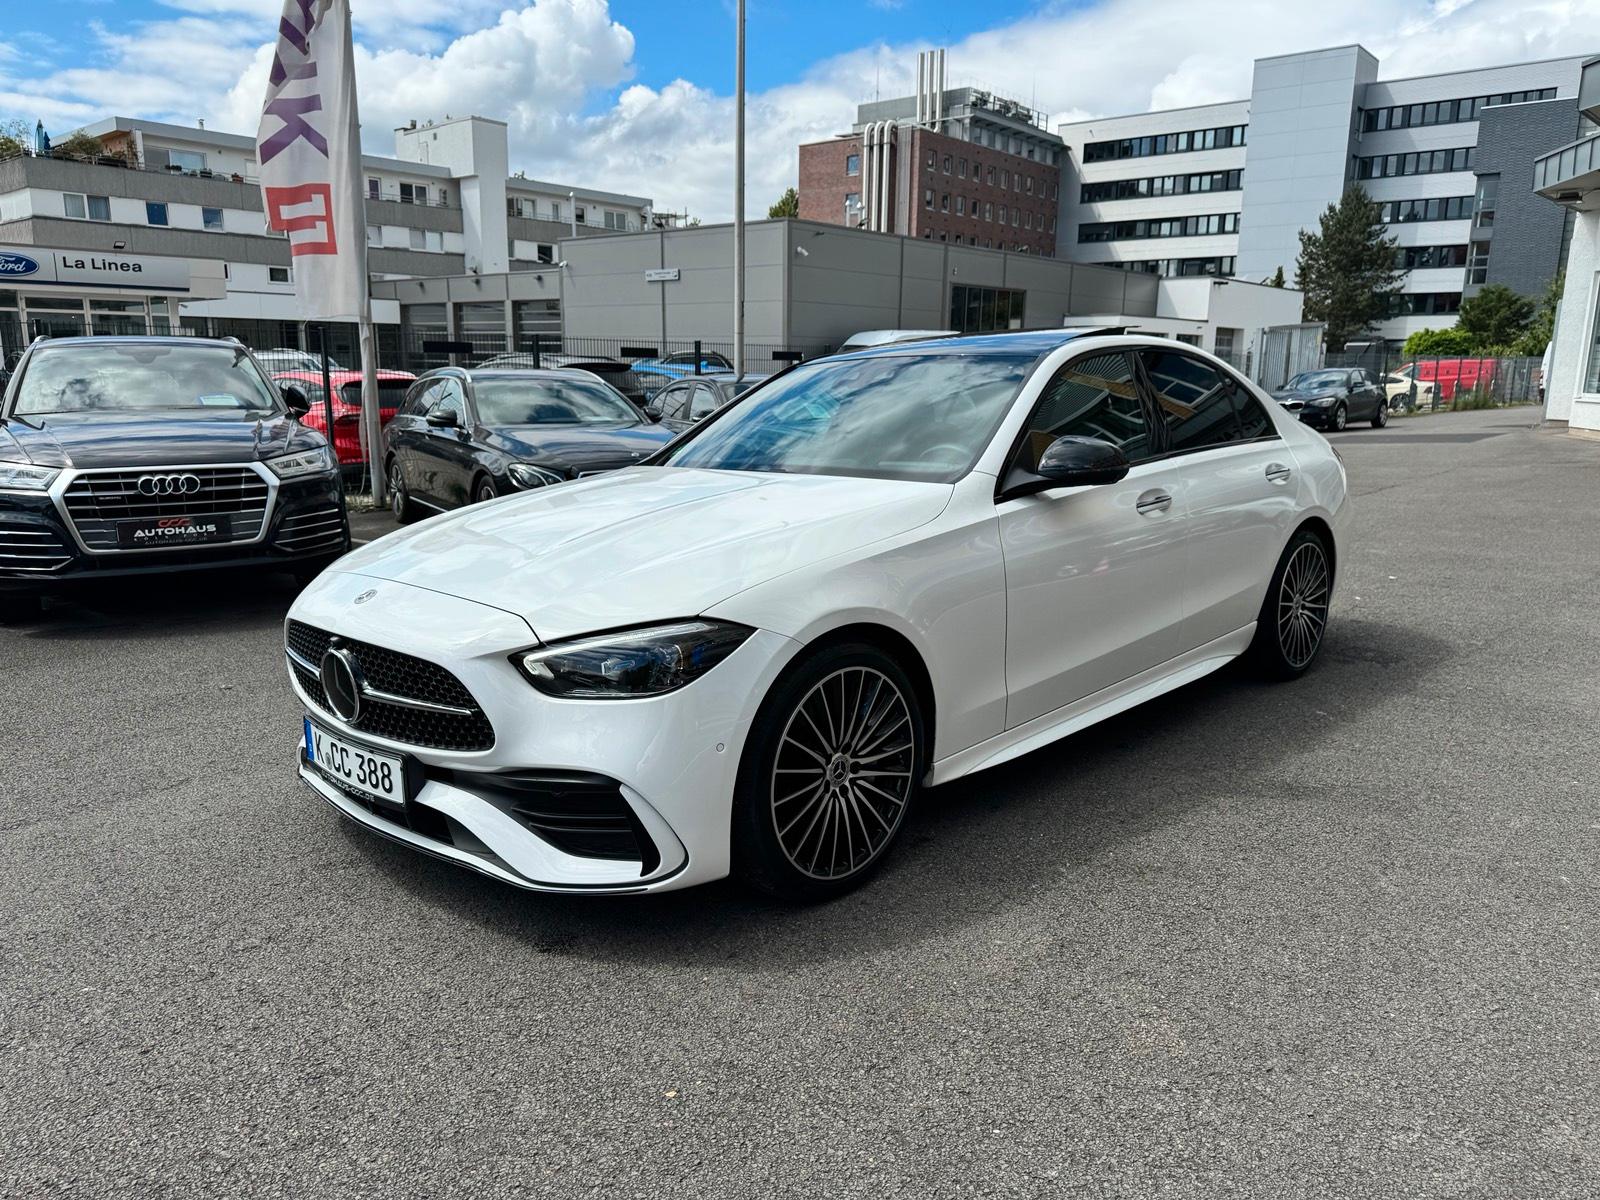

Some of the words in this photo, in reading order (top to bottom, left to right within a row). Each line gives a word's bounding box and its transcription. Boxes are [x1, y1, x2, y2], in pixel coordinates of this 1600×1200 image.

[62, 256, 86, 270] La
[91, 258, 143, 273] Linea
[133, 524, 217, 538] AUTOHAUS
[314, 731, 325, 764] K
[330, 741, 352, 778] CC
[354, 752, 394, 794] 388
